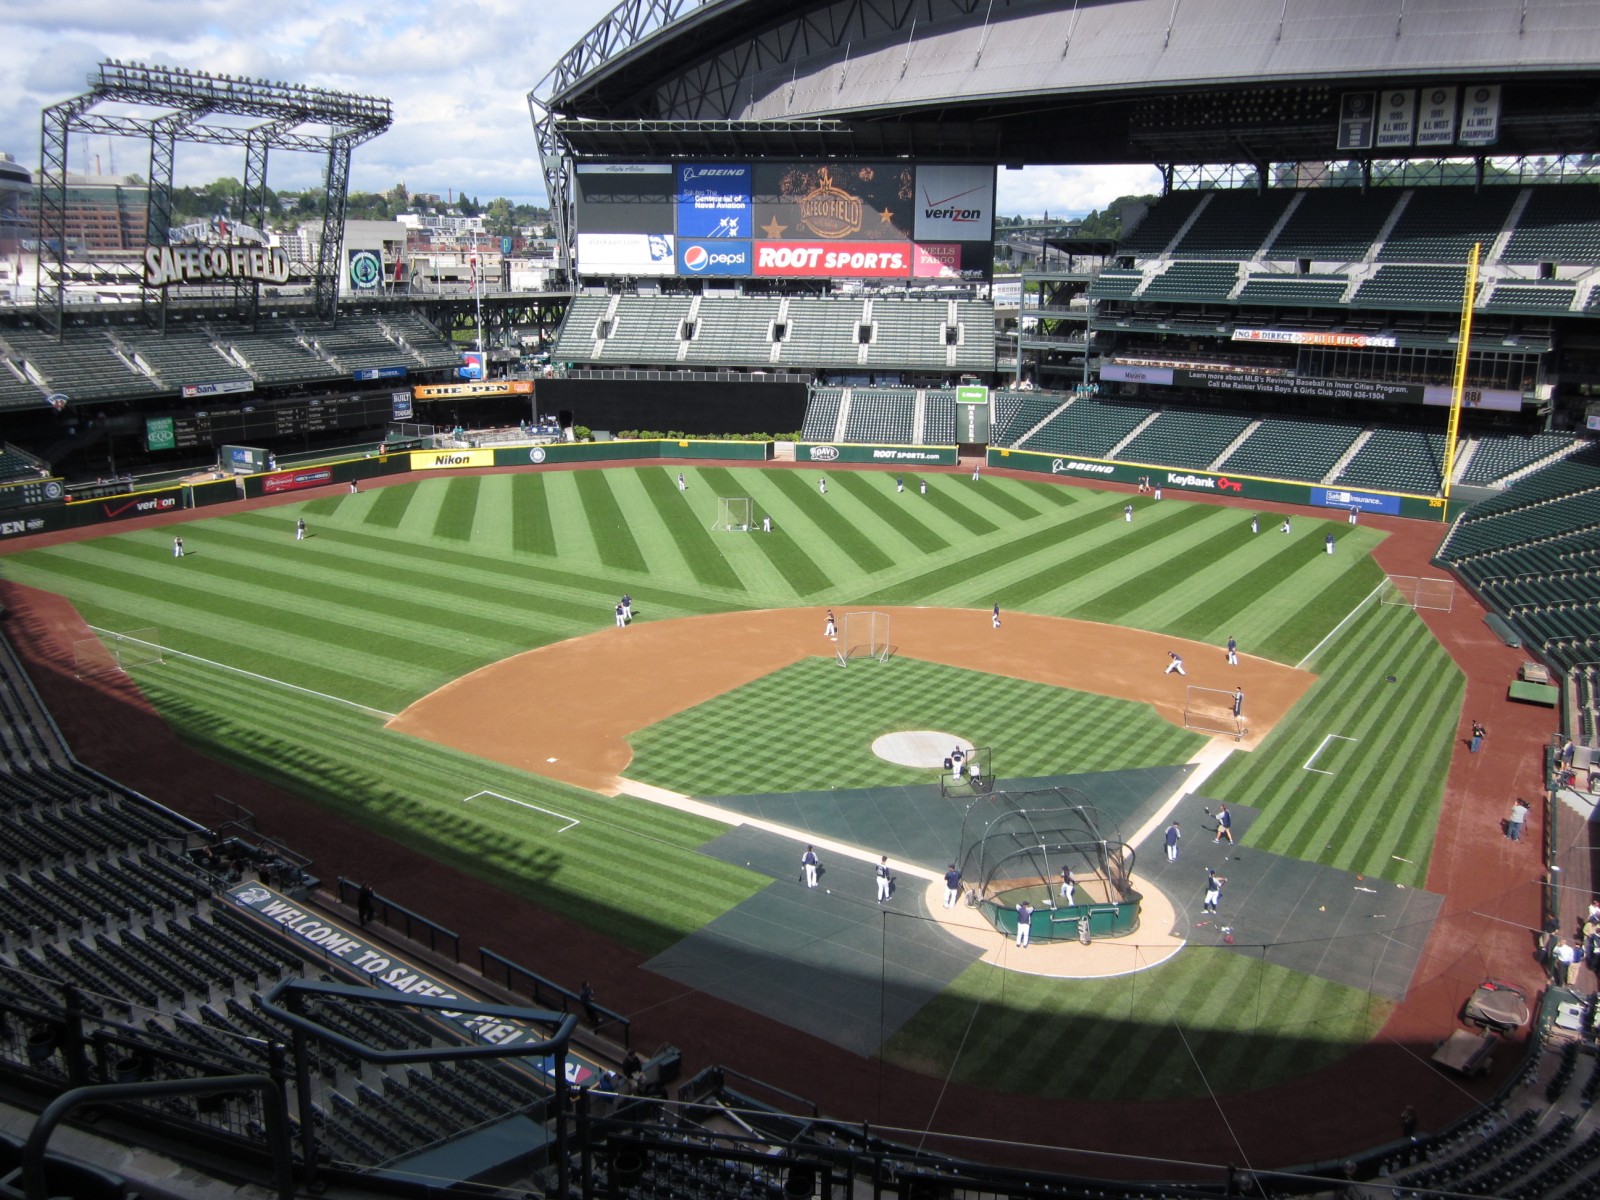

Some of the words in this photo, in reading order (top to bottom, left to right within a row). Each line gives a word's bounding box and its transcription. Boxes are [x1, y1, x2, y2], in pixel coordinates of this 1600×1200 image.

[1393, 122, 1408, 131] WEST
[1434, 120, 1449, 129] WEST
[1476, 118, 1493, 127] WEST
[1378, 134, 1410, 143] CHAMPIONS
[1419, 132, 1451, 142] CHAMPIONS
[1461, 130, 1494, 139] CHAMPIONS
[830, 201, 859, 225] FIELD
[924, 207, 981, 222] verizon
[920, 247, 956, 255] WELLS
[709, 252, 745, 266] pepsi
[759, 247, 824, 268] ROOT
[824, 252, 903, 269] SPORTS
[921, 256, 955, 264] FARGO
[146, 247, 228, 287] SAFECO
[230, 247, 290, 286] FIELD
[1261, 332, 1293, 340] DIRECT
[1189, 371, 1207, 379] Learn
[1245, 375, 1264, 383] MLB's
[1266, 377, 1294, 386] Reviving
[1296, 379, 1325, 387] Baseball
[1335, 381, 1352, 389] Inner
[1376, 384, 1408, 393] Program.
[424, 387, 461, 395] THE
[1256, 384, 1273, 392] Vista
[1274, 385, 1291, 393] Boys
[1317, 388, 1333, 396] Club
[1334, 389, 1352, 398] (206)
[1353, 391, 1385, 400] 436-1904
[394, 394, 410, 402] BUILT
[967, 404, 976, 443] MARINERS
[816, 447, 835, 457] DAVE
[873, 450, 897, 458] ROOT
[897, 452, 940, 460] SPORTS.com
[434, 455, 470, 466] Nikon
[1066, 462, 1115, 474] BOEING
[1167, 472, 1215, 488] KeyBank
[136, 498, 175, 511] verizon
[1350, 494, 1380, 505] Insurance
[0, 520, 26, 535] EN
[260, 899, 361, 958] WELCOME
[350, 950, 391, 975] TO
[381, 967, 463, 1018] SAFE
[463, 1015, 536, 1045] FIEL
